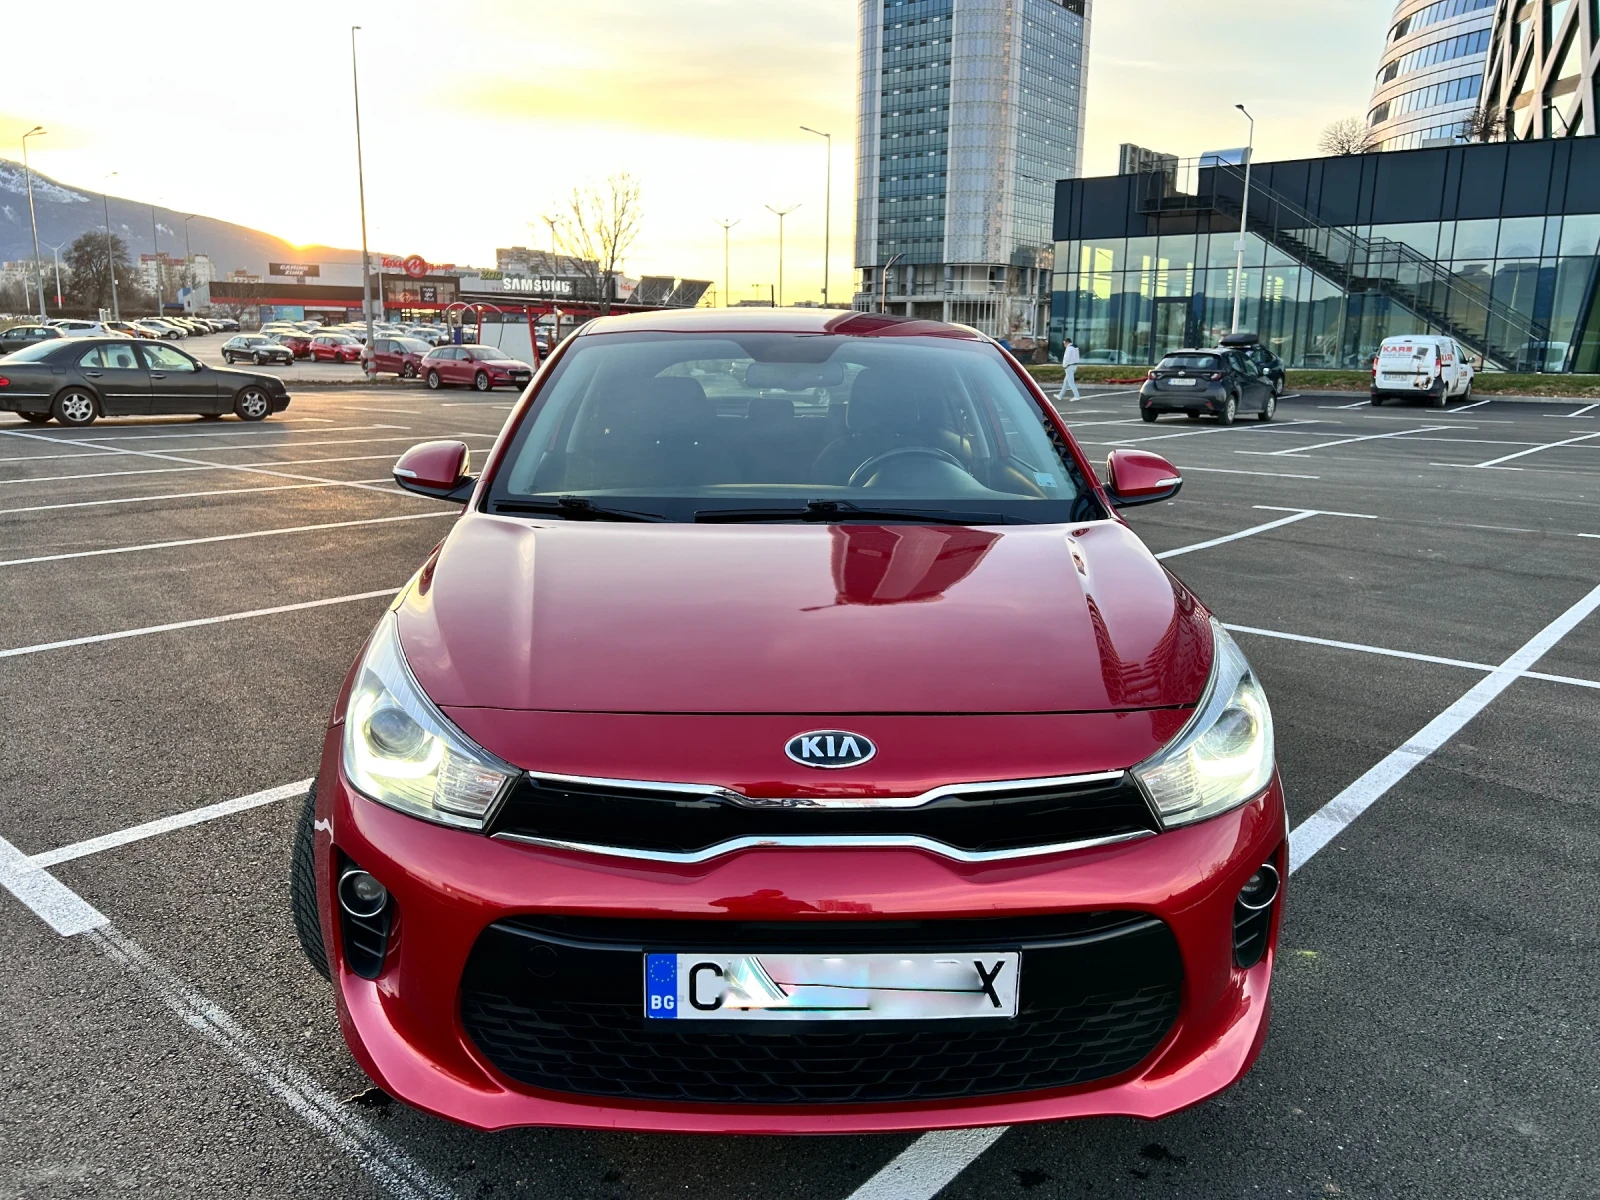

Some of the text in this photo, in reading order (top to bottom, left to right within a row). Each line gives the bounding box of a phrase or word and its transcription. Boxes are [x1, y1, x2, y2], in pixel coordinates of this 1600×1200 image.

[502, 277, 571, 293] SAMSUNG
[801, 735, 862, 758] KIA
[650, 994, 676, 1010] BG
